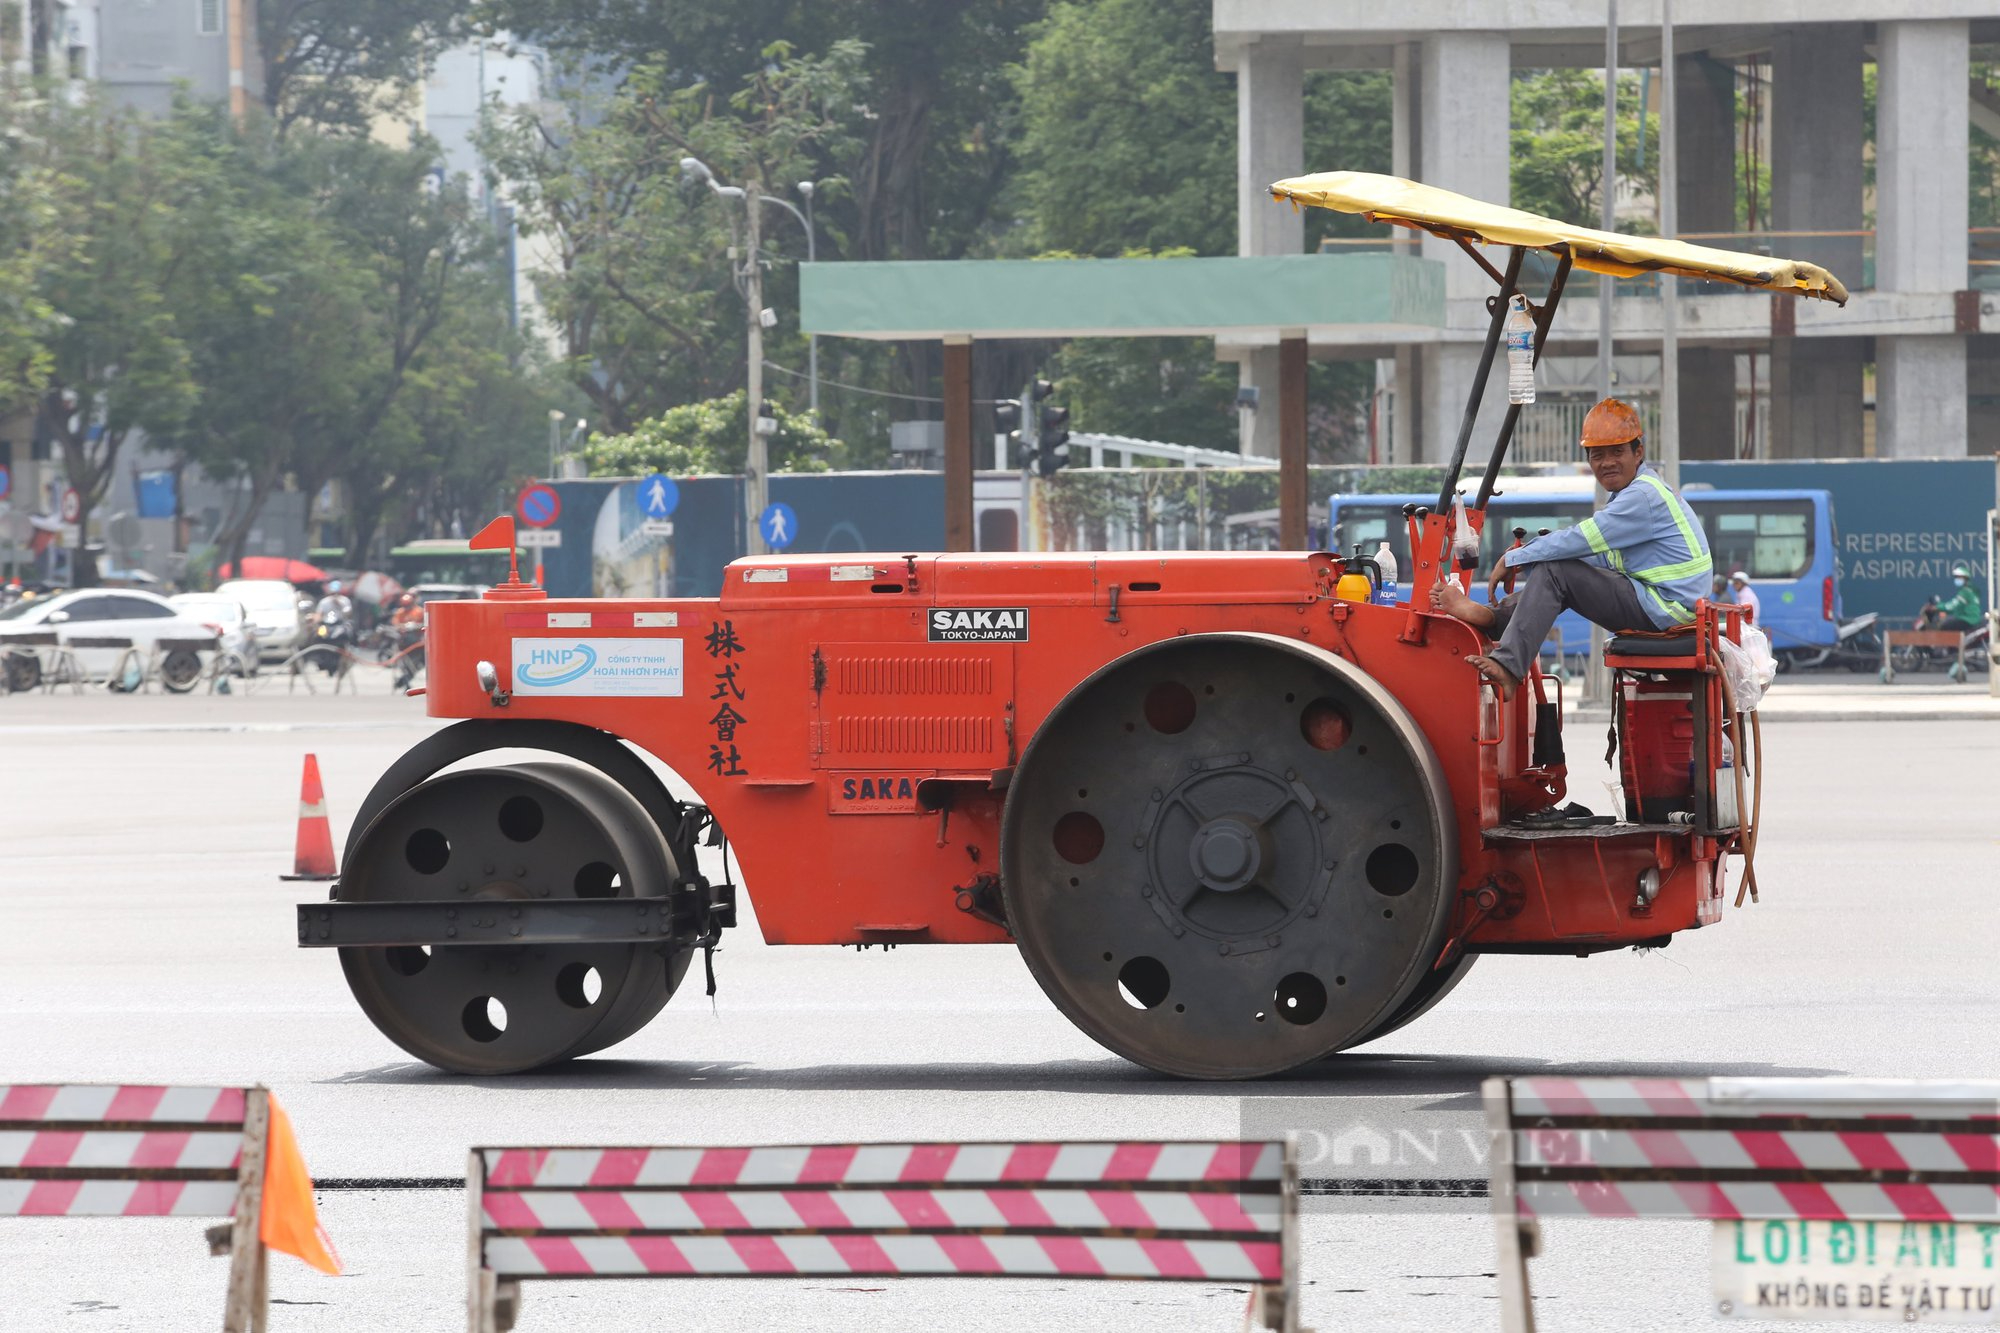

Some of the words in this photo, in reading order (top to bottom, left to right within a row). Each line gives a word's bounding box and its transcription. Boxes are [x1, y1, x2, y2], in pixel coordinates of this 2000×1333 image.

[1846, 533, 1988, 552] REPRESENTS
[1852, 559, 1988, 580] ASPIRATION
[933, 611, 1024, 630] SAKAI
[941, 631, 1016, 640] TOKYO-JAPAN
[531, 649, 573, 665] HNP
[632, 656, 642, 664] TY
[643, 656, 666, 664] TNHH
[704, 619, 749, 777] 株式會社
[843, 778, 921, 800] SAKA
[1757, 1277, 1848, 1308] KHÔNG
